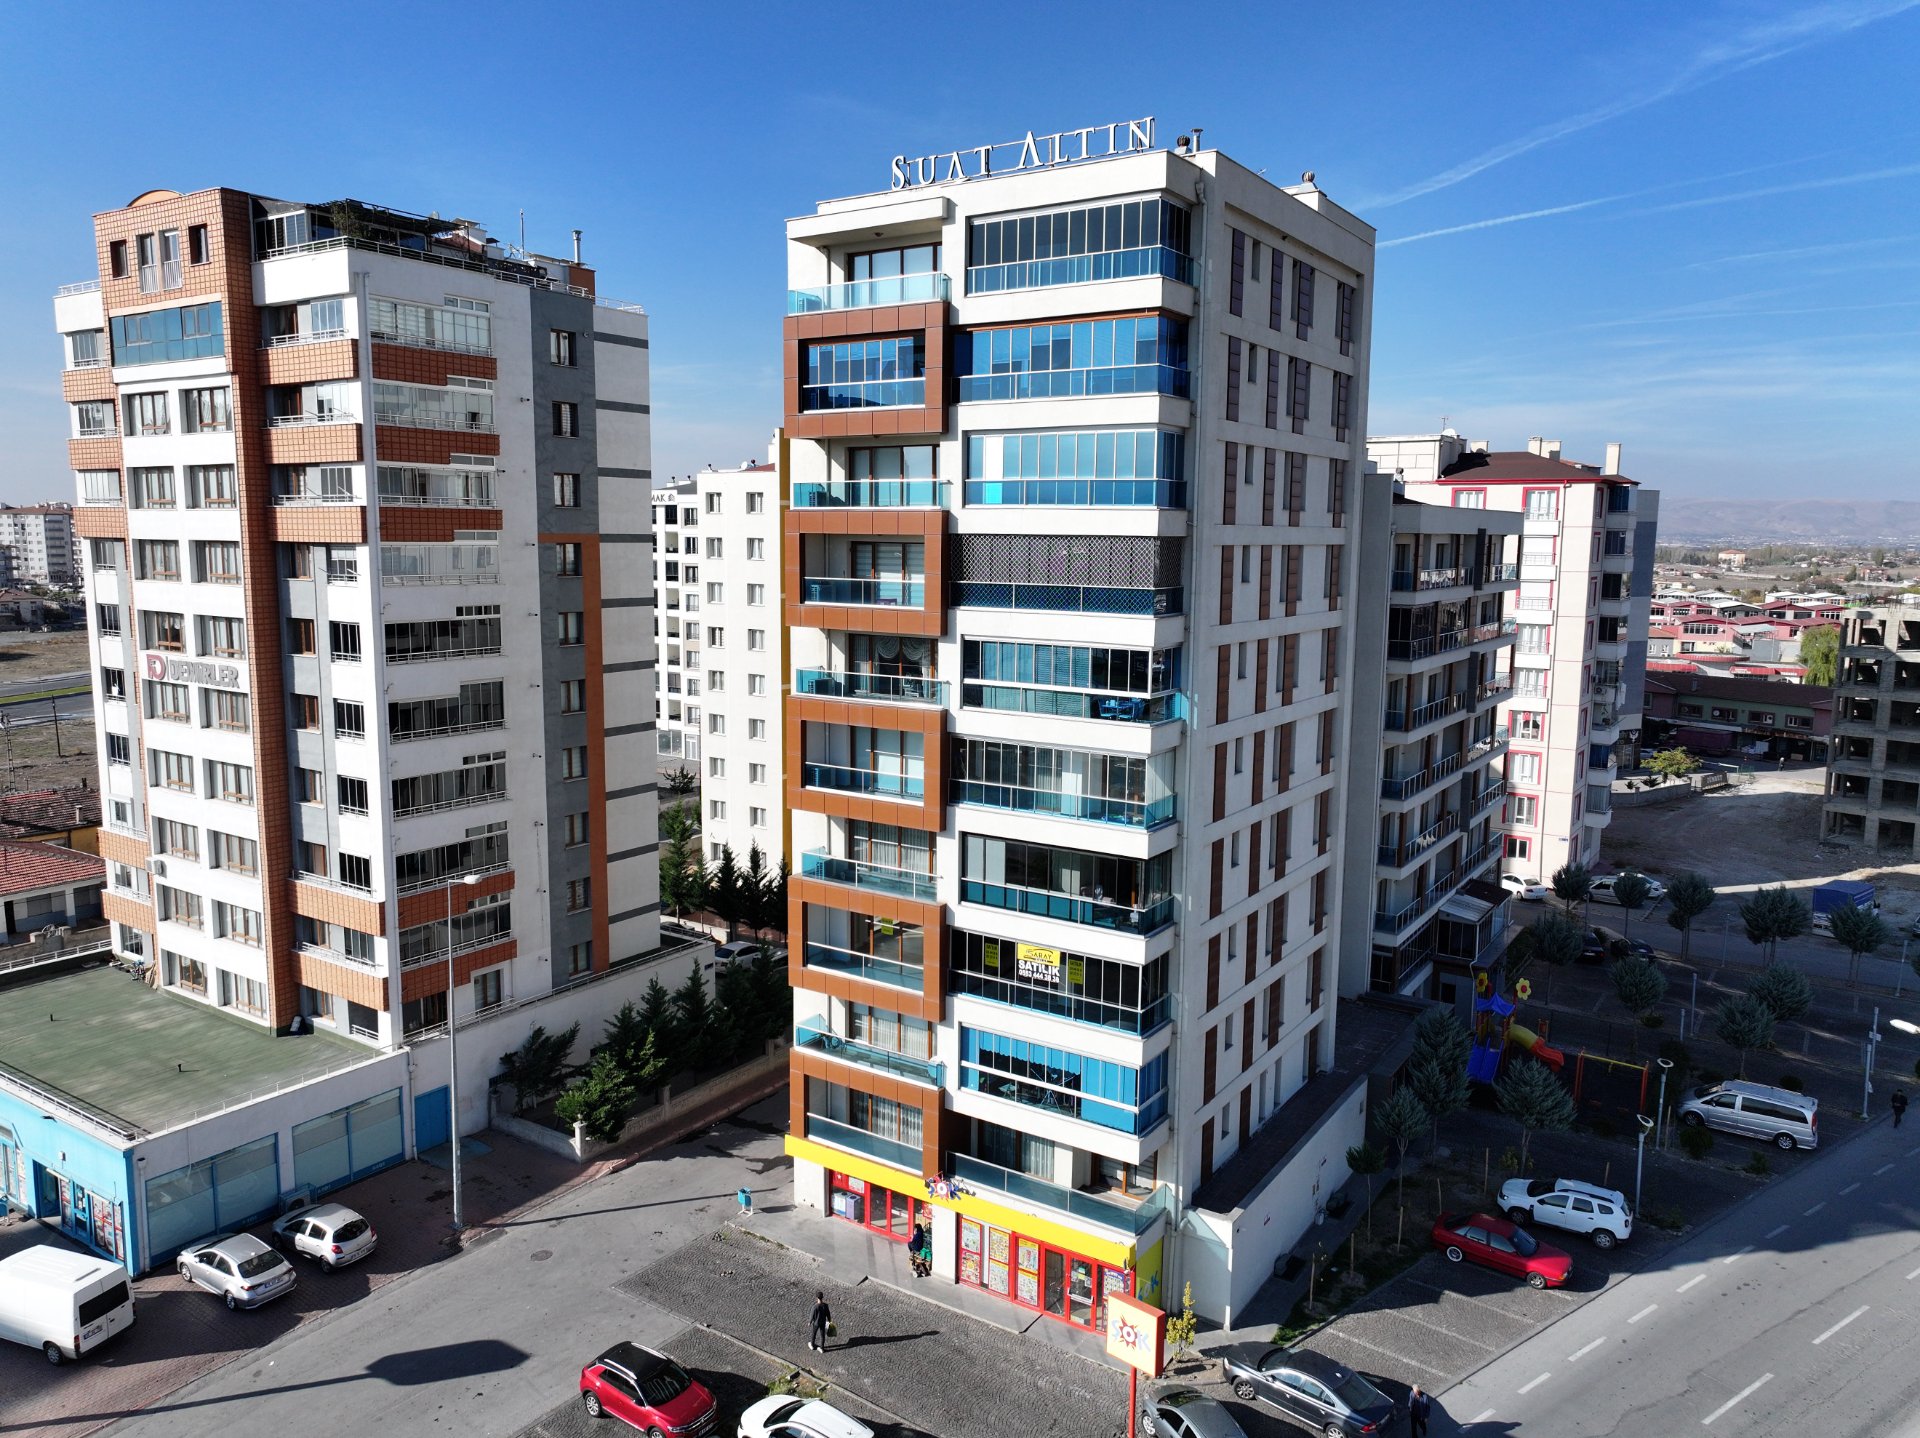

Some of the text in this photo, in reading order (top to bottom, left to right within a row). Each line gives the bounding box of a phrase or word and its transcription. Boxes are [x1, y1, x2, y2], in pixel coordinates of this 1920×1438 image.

[892, 116, 1155, 191] SUAT ALTIN
[1018, 959, 1060, 976] SATILIK
